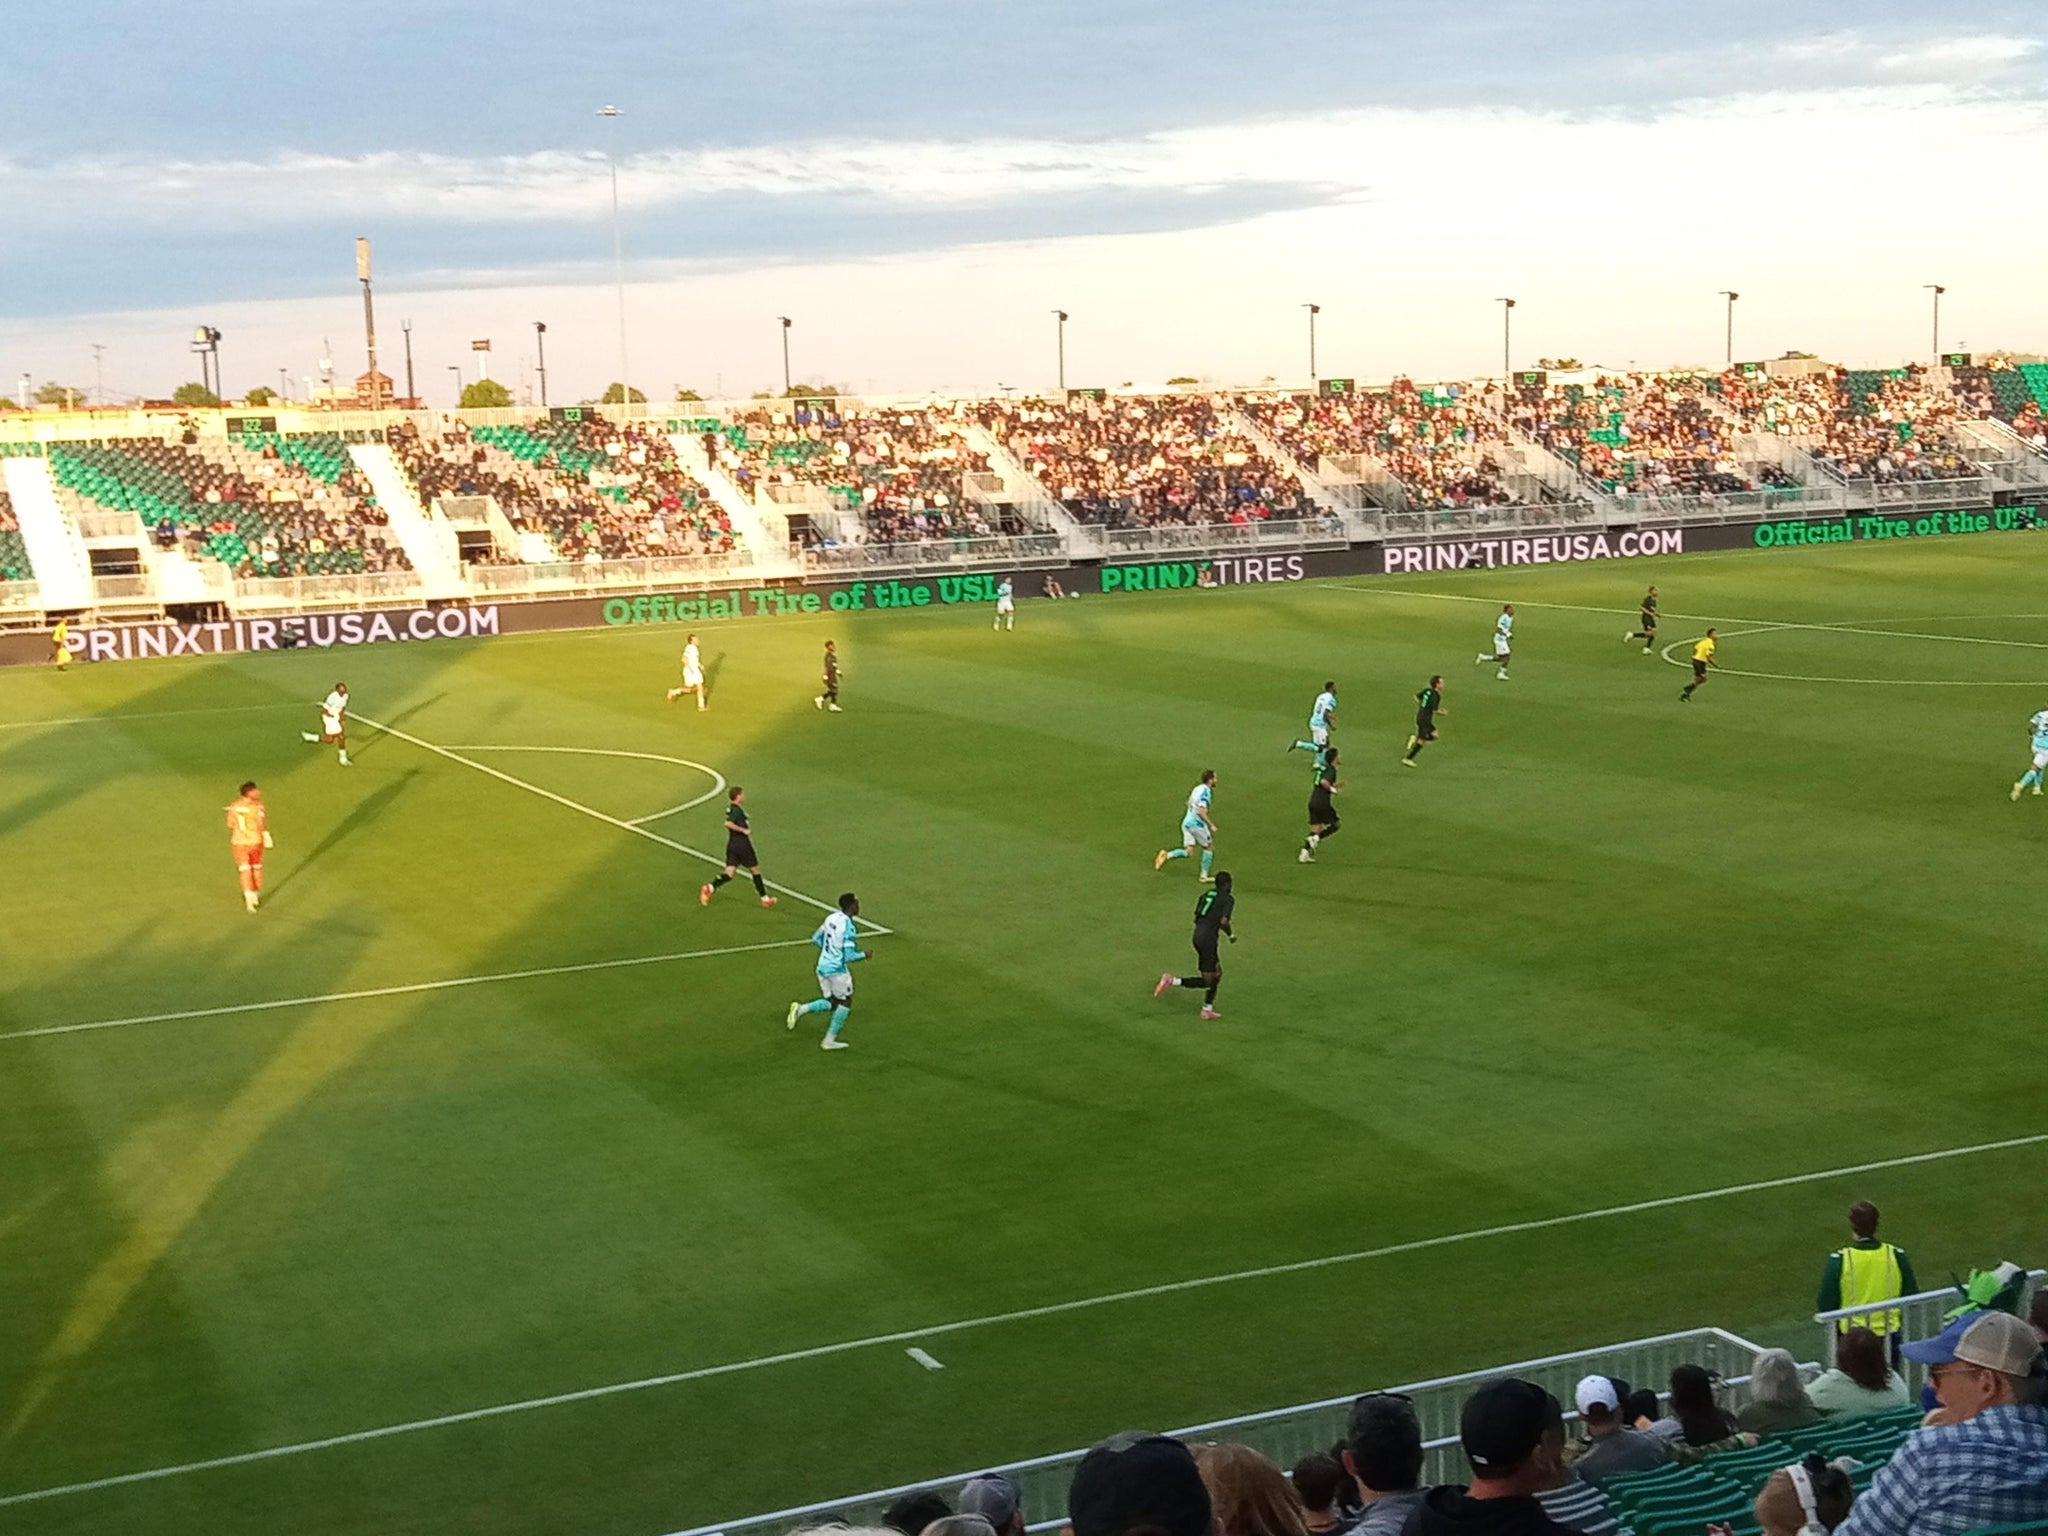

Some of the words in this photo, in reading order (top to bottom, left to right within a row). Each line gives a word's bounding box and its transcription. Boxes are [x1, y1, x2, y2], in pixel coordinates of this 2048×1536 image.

[1754, 519, 1853, 547] Official
[1858, 516, 1909, 538] Tire
[1916, 512, 1943, 535] of
[1947, 511, 1989, 533] the
[1213, 556, 1304, 585] TIRES
[1384, 530, 1683, 574] PRINXTIREUSA.COM
[603, 590, 742, 625] Official
[749, 588, 821, 616] Tire
[829, 583, 866, 611] of
[873, 581, 931, 608] the
[64, 606, 498, 661] PRINXTIREUSA.COM
